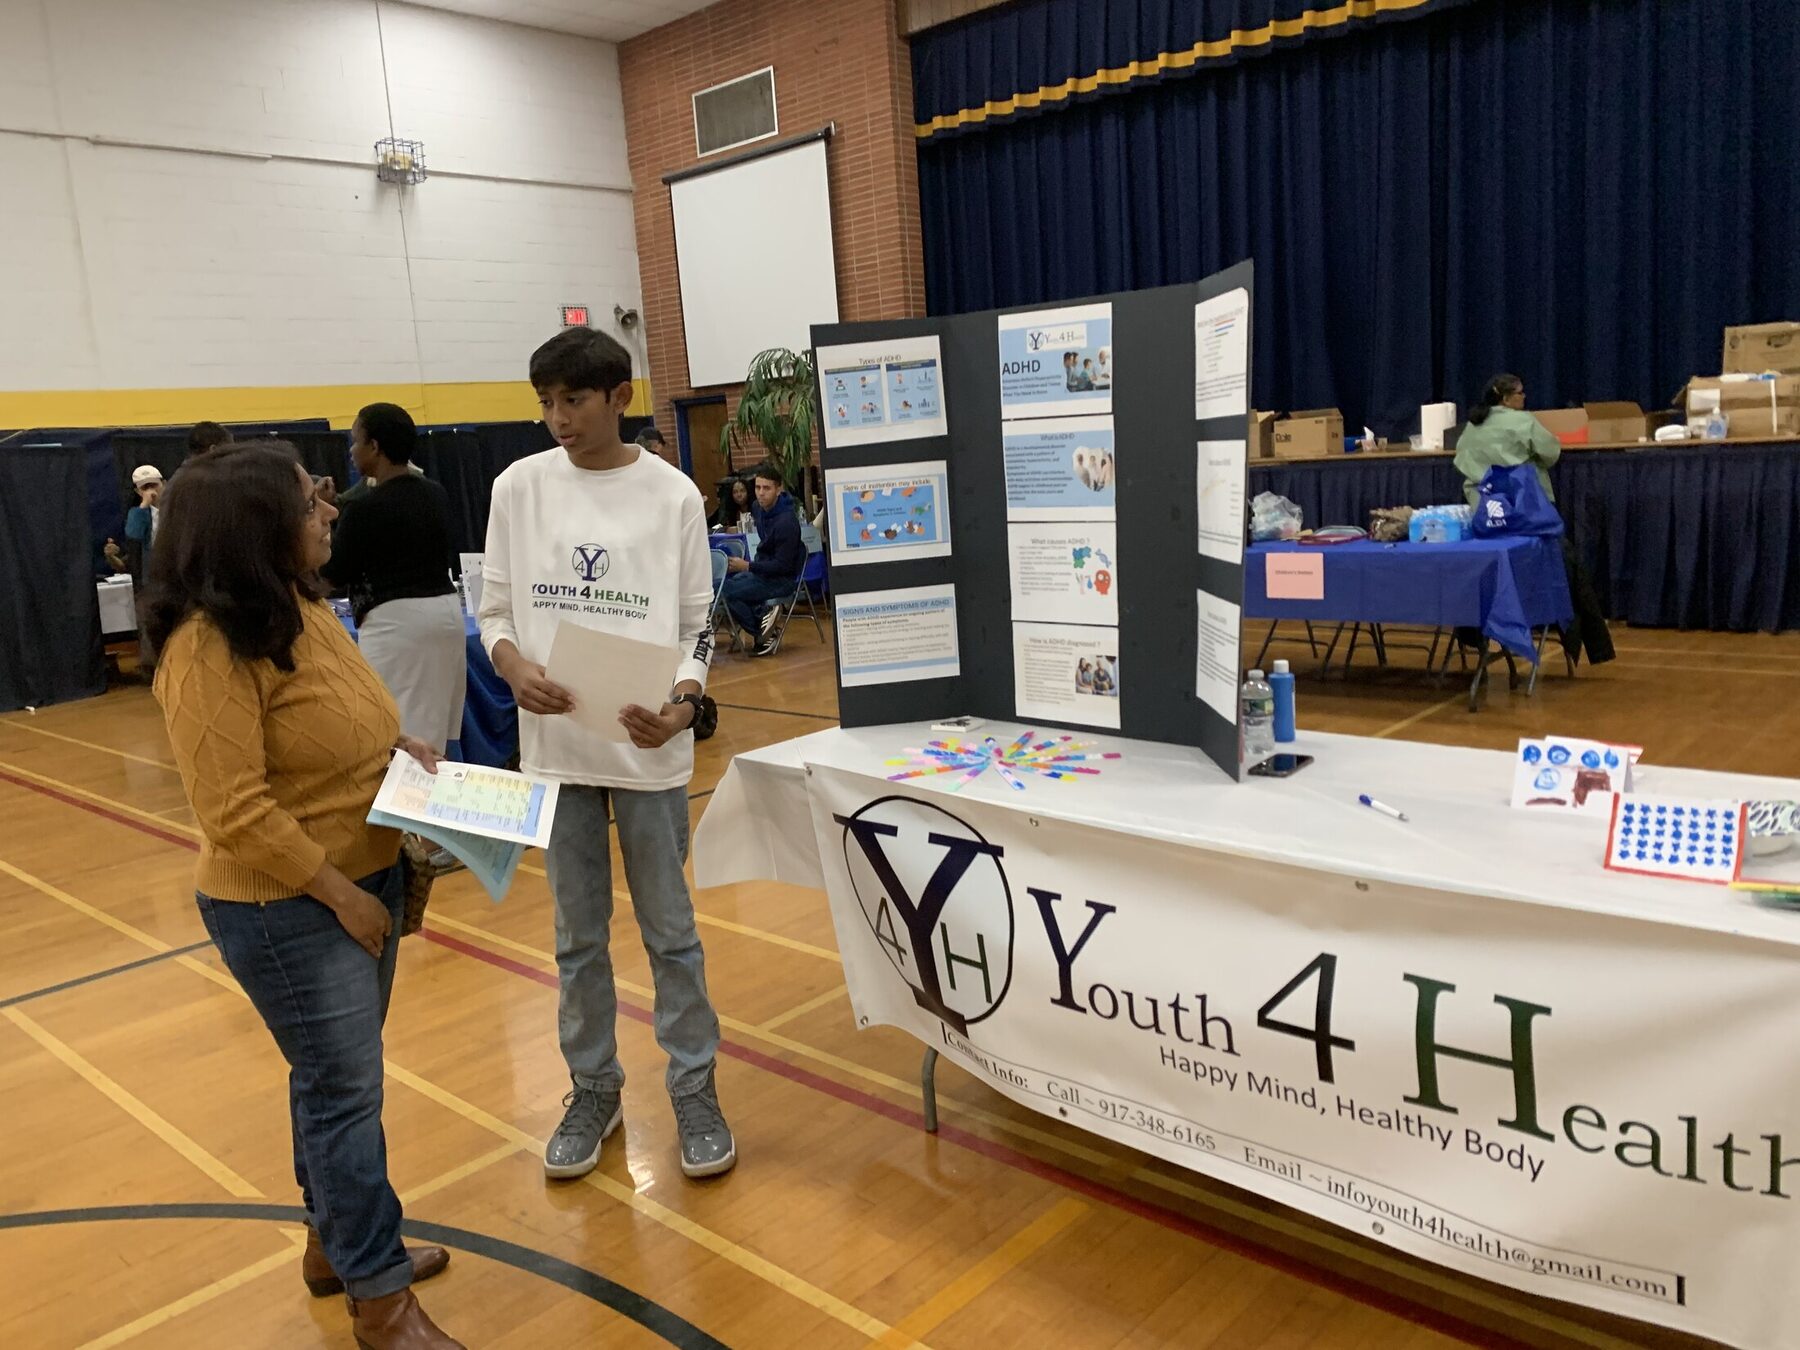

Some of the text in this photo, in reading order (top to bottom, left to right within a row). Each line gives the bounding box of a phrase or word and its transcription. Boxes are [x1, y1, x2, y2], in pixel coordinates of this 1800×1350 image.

[884, 354, 901, 363] ADHD
[1002, 359, 1041, 375] ADHD
[574, 546, 608, 582] Y
[574, 560, 605, 575] 4 H
[532, 601, 557, 609] APPY
[583, 605, 623, 616] HEALTHY
[625, 610, 647, 620] BODY
[580, 586, 591, 599] 4
[594, 589, 649, 607] HEALTH
[865, 605, 880, 614] AND
[881, 601, 919, 612] SYMPTOMS
[920, 600, 929, 608] OF
[833, 813, 1005, 1040] Y
[876, 897, 993, 1004] 4 H
[1027, 887, 1241, 1057] Youth
[1257, 952, 1356, 1084] 4
[1160, 1046, 1546, 1183] Happy Mind, Healthy Body
[993, 1061, 1028, 1088] Info:
[1047, 1080, 1080, 1106] Call
[1099, 1099, 1217, 1151] 917-348-6165
[1243, 1146, 1302, 1181] Email
[1327, 1175, 1667, 1297] infoyouth4health@gmail.com
